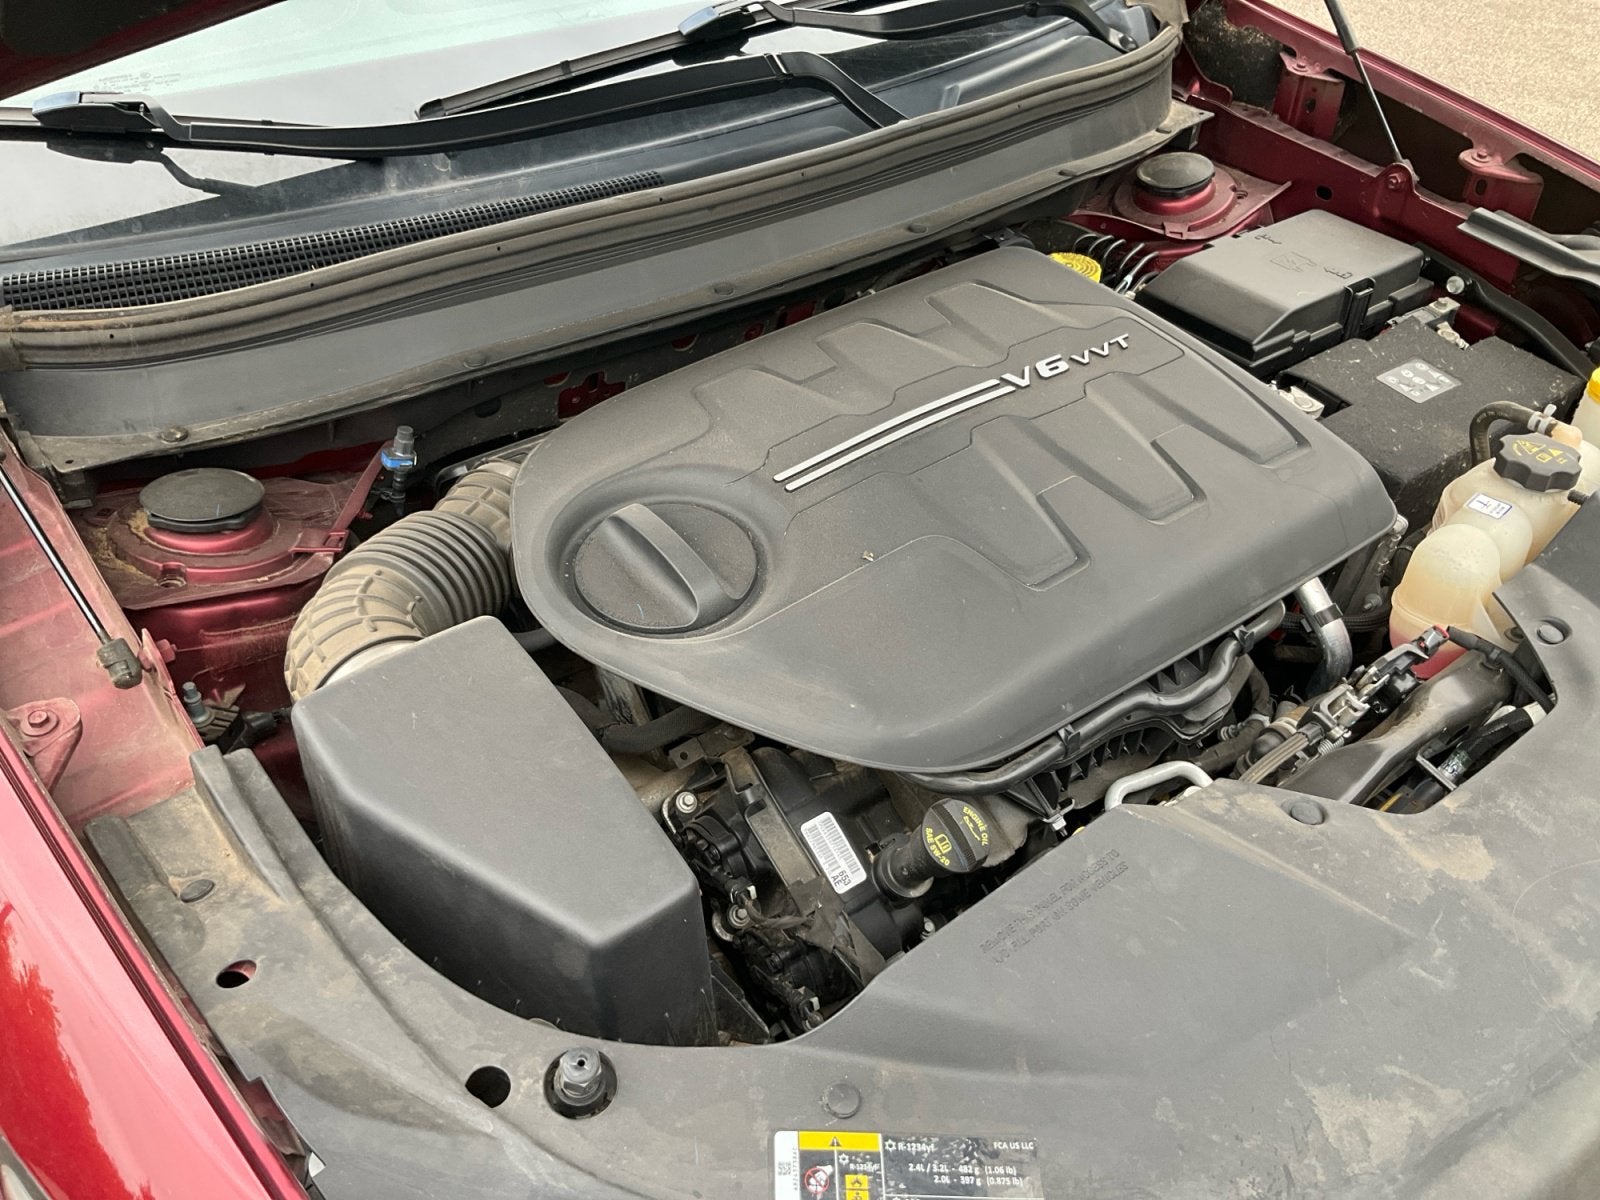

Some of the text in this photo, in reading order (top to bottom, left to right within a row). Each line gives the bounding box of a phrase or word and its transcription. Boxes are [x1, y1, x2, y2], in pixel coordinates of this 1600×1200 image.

[1001, 333, 1129, 388] V6 VVT
[963, 806, 989, 846] ENGINE OIL
[925, 827, 950, 866] SAE 5W-20
[1106, 848, 1120, 861] TO
[831, 875, 842, 887] AE
[838, 870, 851, 886] 653
[993, 1142, 1034, 1150] FCA US LLC
[908, 1163, 925, 1172] 2.4L
[984, 1165, 1005, 1175] (1.06
[1005, 1165, 1017, 1176] lb)
[934, 1174, 950, 1184] 2.0L
[986, 1176, 1011, 1187] (0.875
[1012, 1176, 1024, 1188] lb)
